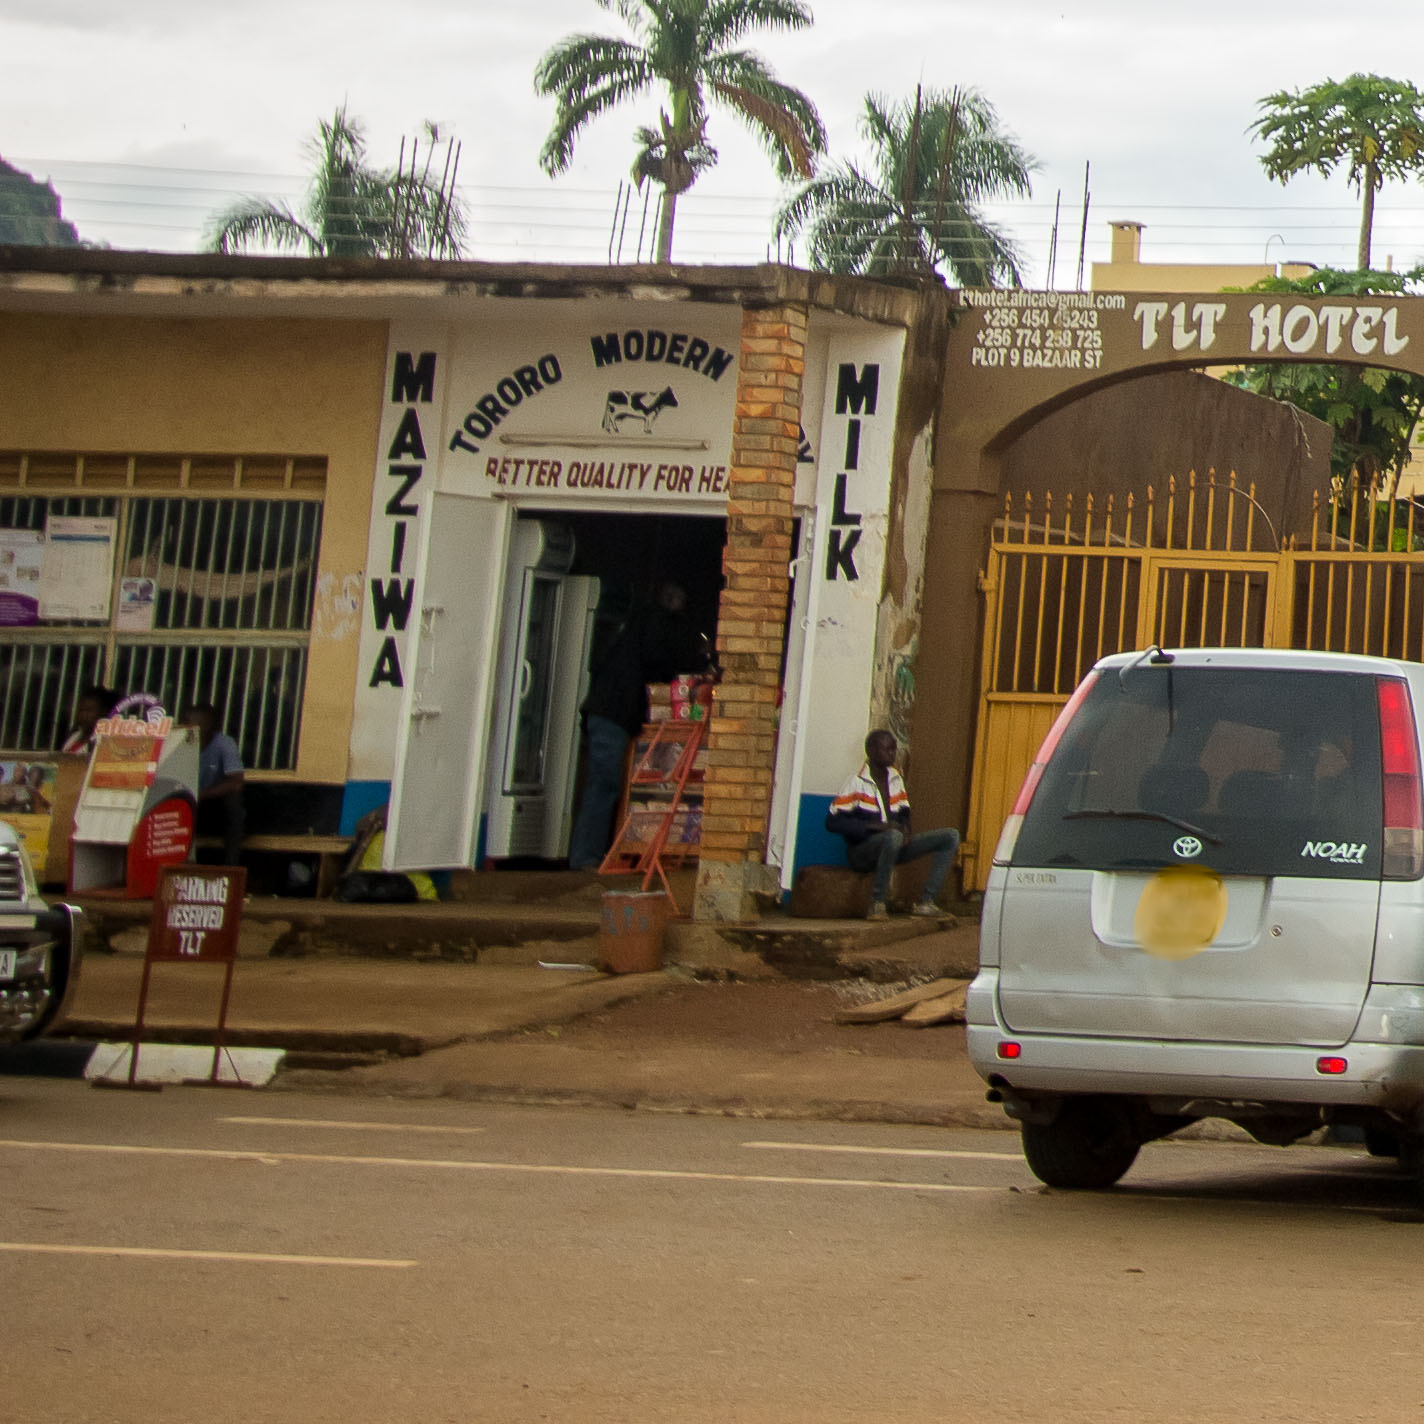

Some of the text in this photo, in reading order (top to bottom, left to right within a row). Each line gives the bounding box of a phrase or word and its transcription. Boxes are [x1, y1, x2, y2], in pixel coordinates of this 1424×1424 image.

[983, 308, 1019, 328] +256
[1022, 309, 1049, 328] 454
[1133, 301, 1410, 356] TLT HOTEL
[976, 328, 1102, 349] +256 774 258 725
[972, 347, 1103, 369] PLOT 9 BAZAAR ST
[449, 329, 734, 454] TORORO MODERN
[566, 461, 652, 491] QUALITY
[653, 463, 694, 493] FOR
[826, 363, 879, 581] MILK
[369, 352, 437, 688] MAZIWA
[1301, 841, 1368, 858] NOAH
[179, 931, 206, 954] TLT
